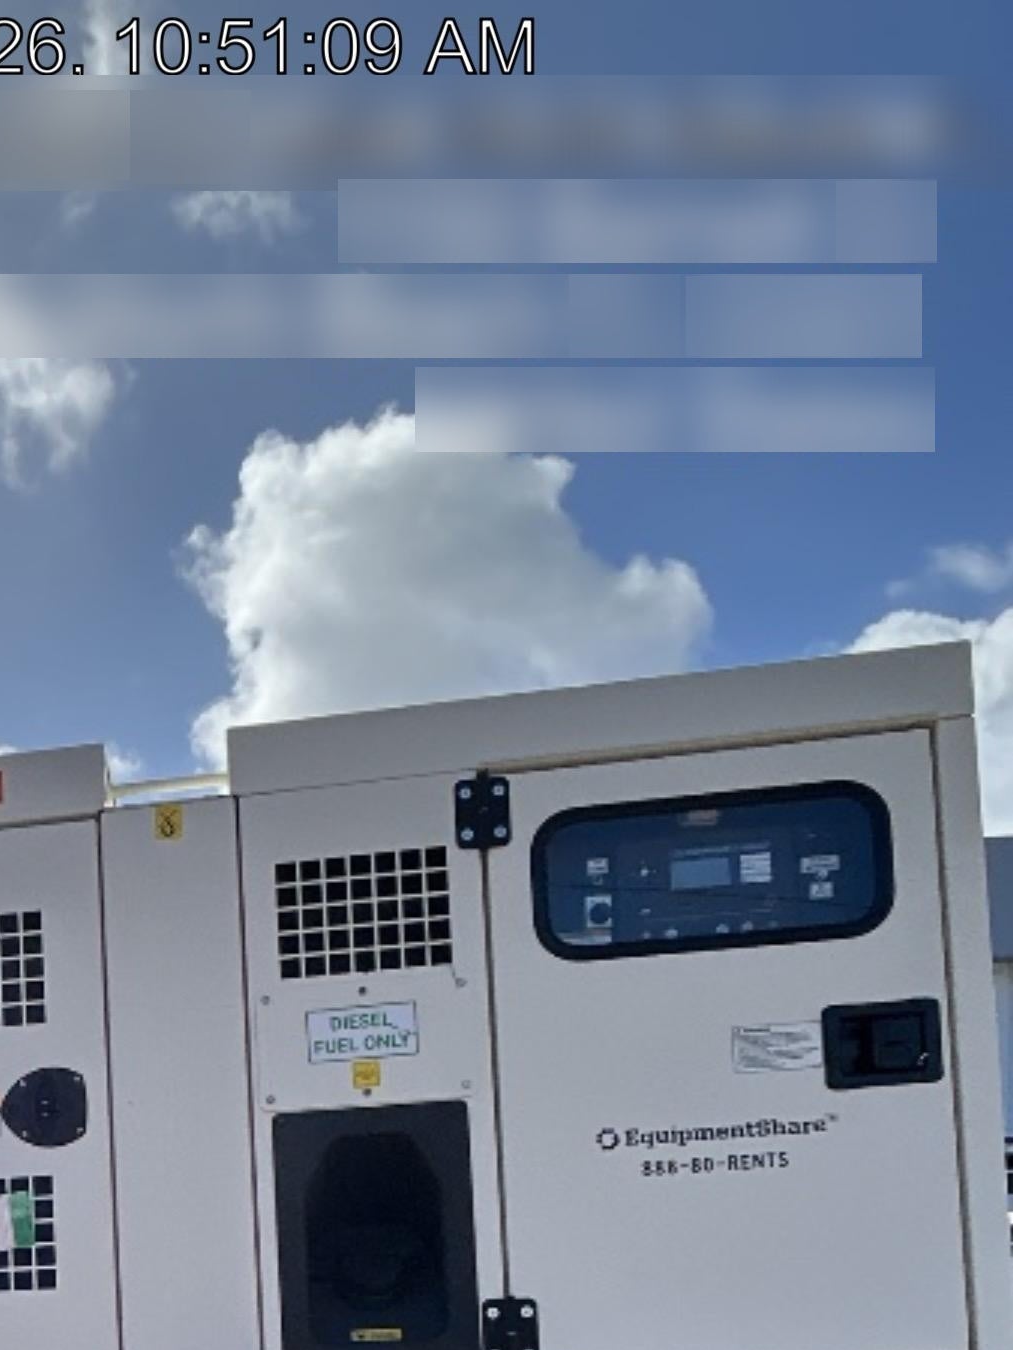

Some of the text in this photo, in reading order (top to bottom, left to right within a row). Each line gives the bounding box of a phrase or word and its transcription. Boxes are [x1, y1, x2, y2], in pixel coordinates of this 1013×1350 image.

[330, 1013, 393, 1032] DIESEL
[313, 1030, 409, 1054] FUEL ONLY
